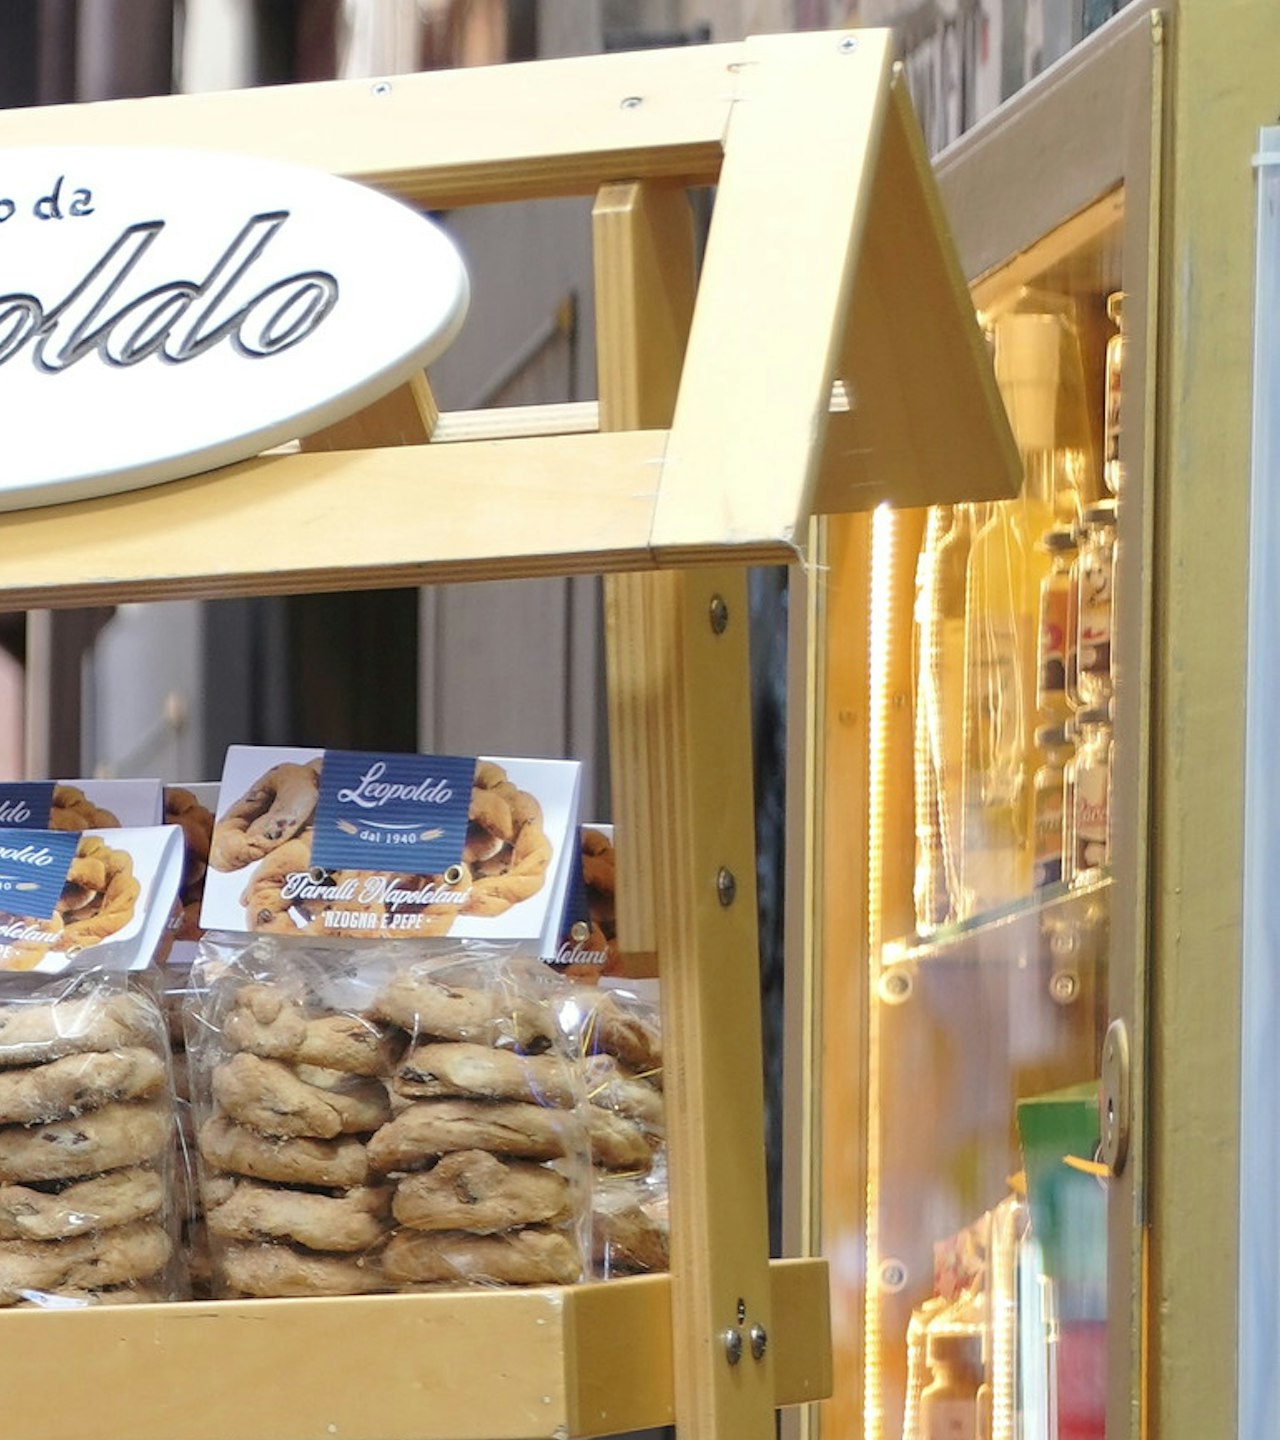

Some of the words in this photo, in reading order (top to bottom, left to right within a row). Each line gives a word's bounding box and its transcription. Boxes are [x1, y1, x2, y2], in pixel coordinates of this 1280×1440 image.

[32, 174, 96, 221] da
[338, 762, 453, 807] Leopoldo
[359, 829, 380, 843] dal
[385, 831, 417, 845] 1940
[280, 873, 354, 904] Taralli
[359, 874, 472, 917] Napoletani
[379, 912, 387, 929] E
[387, 913, 423, 930] PEPE
